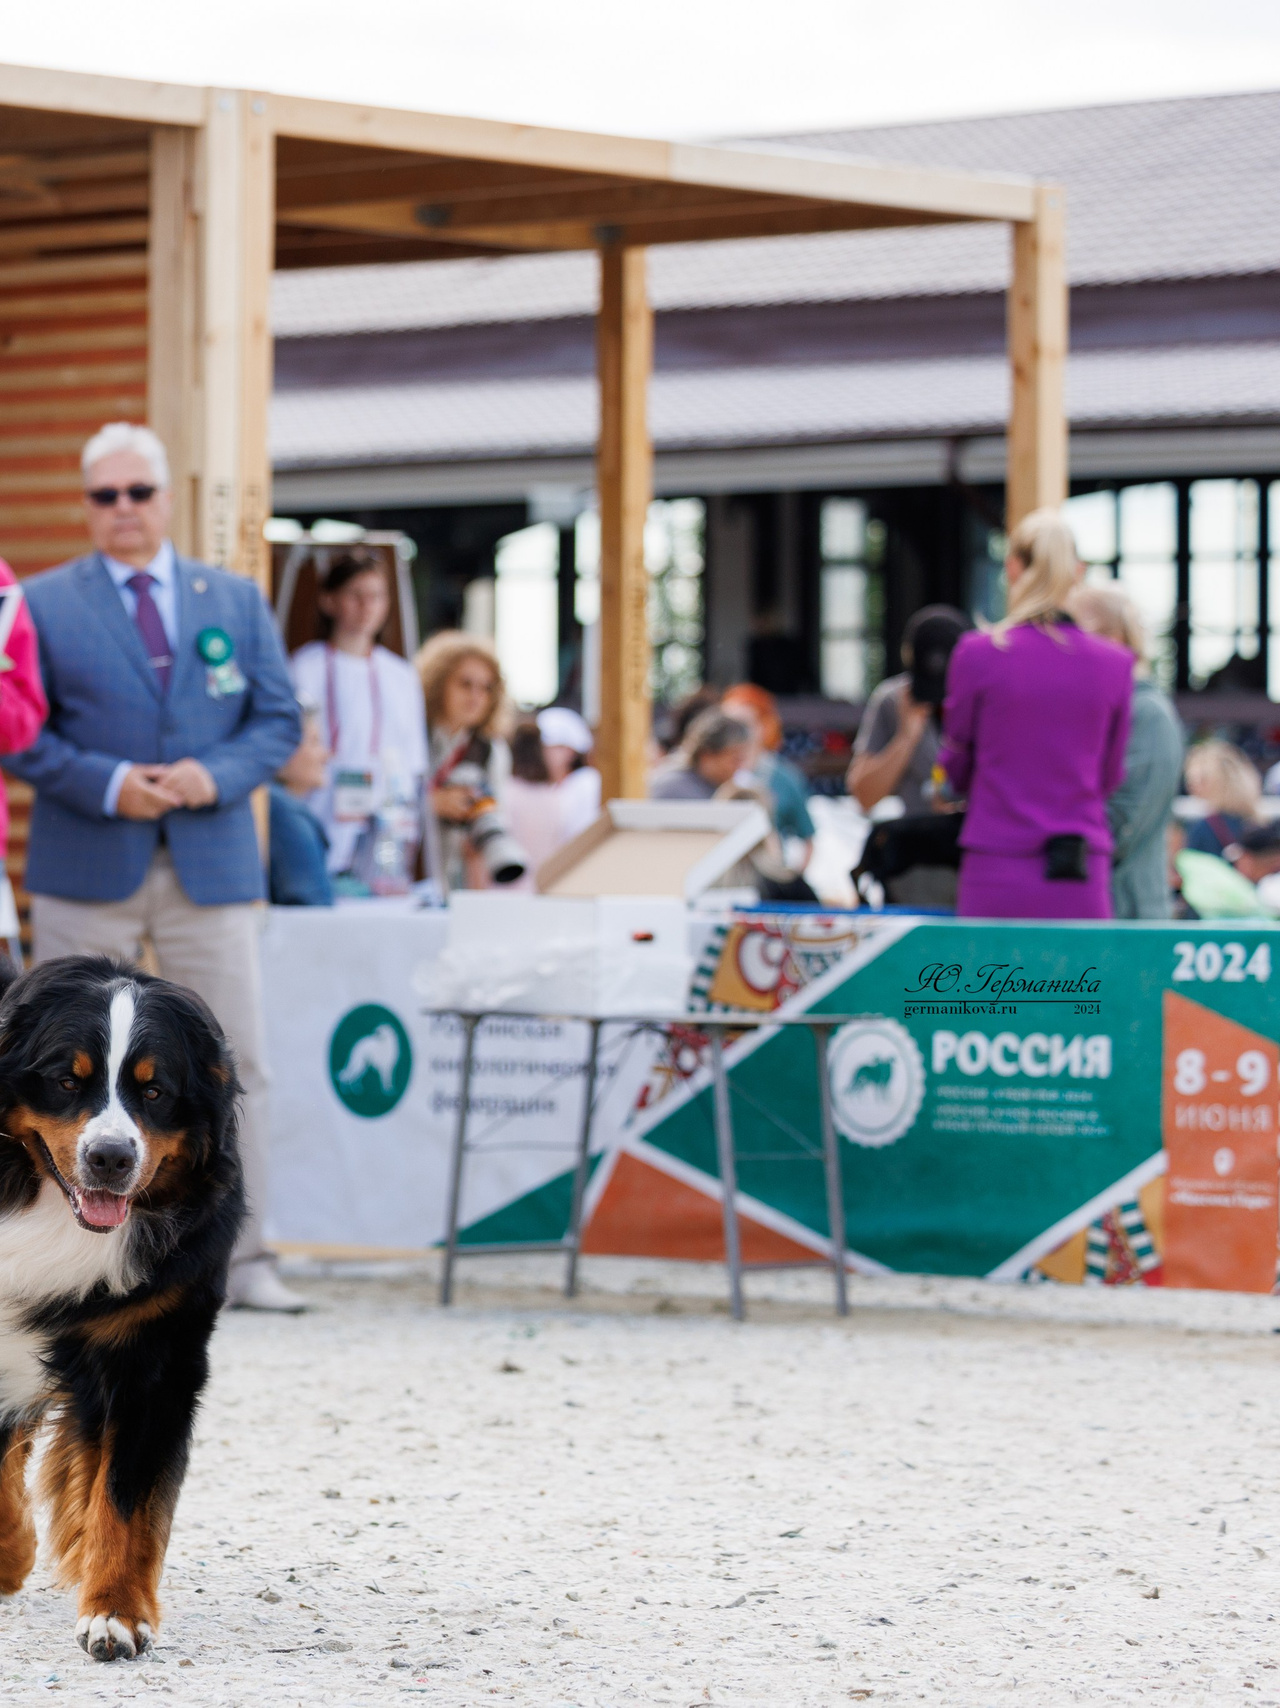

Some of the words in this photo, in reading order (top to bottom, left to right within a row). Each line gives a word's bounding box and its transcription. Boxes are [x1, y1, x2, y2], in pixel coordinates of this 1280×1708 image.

[1172, 941, 1271, 983] 2024
[932, 1030, 1112, 1078] РОССИЯ
[1175, 1103, 1272, 1132] ИЮНЯ
